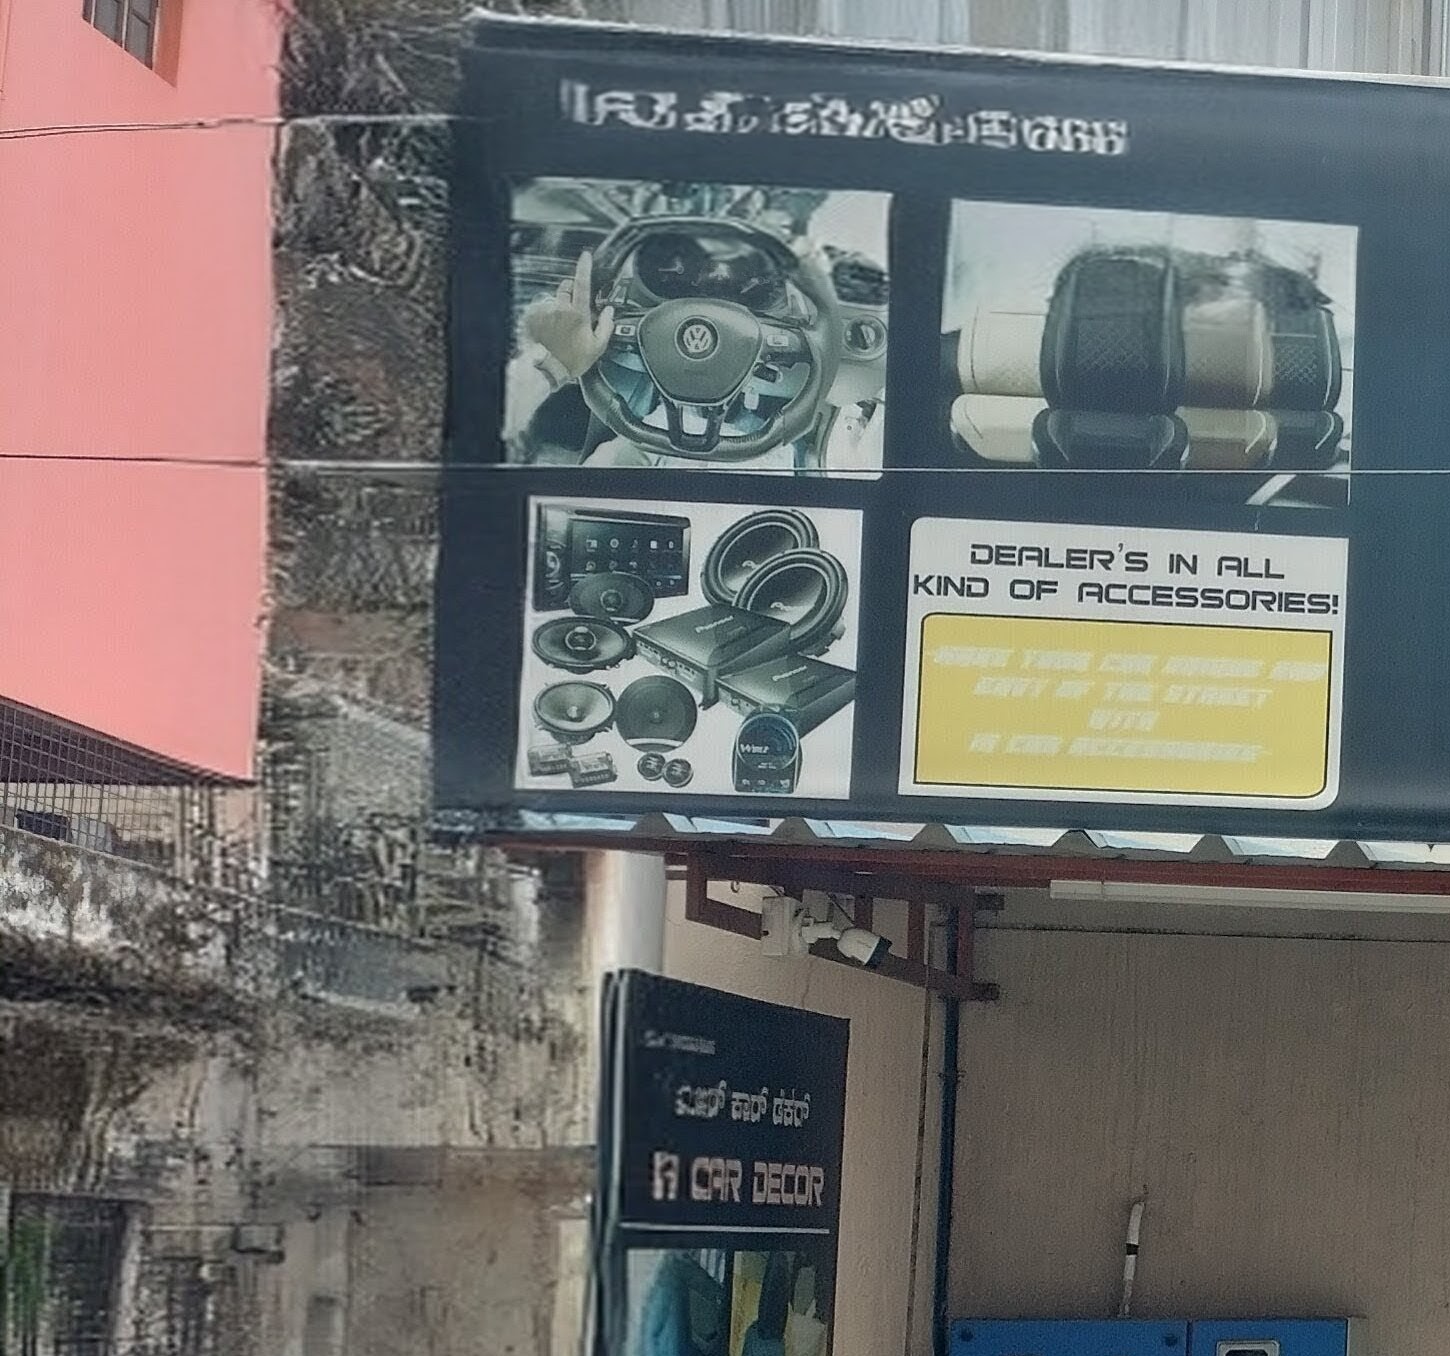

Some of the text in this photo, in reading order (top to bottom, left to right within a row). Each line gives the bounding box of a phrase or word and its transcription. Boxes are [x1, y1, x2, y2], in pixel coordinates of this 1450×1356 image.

[970, 541, 1285, 580] DEALER'S IN ALL
[913, 574, 1339, 615] KIND OF ACCESSORIES!
[691, 1157, 743, 1202] CAR
[752, 1161, 825, 1206] DECOR
